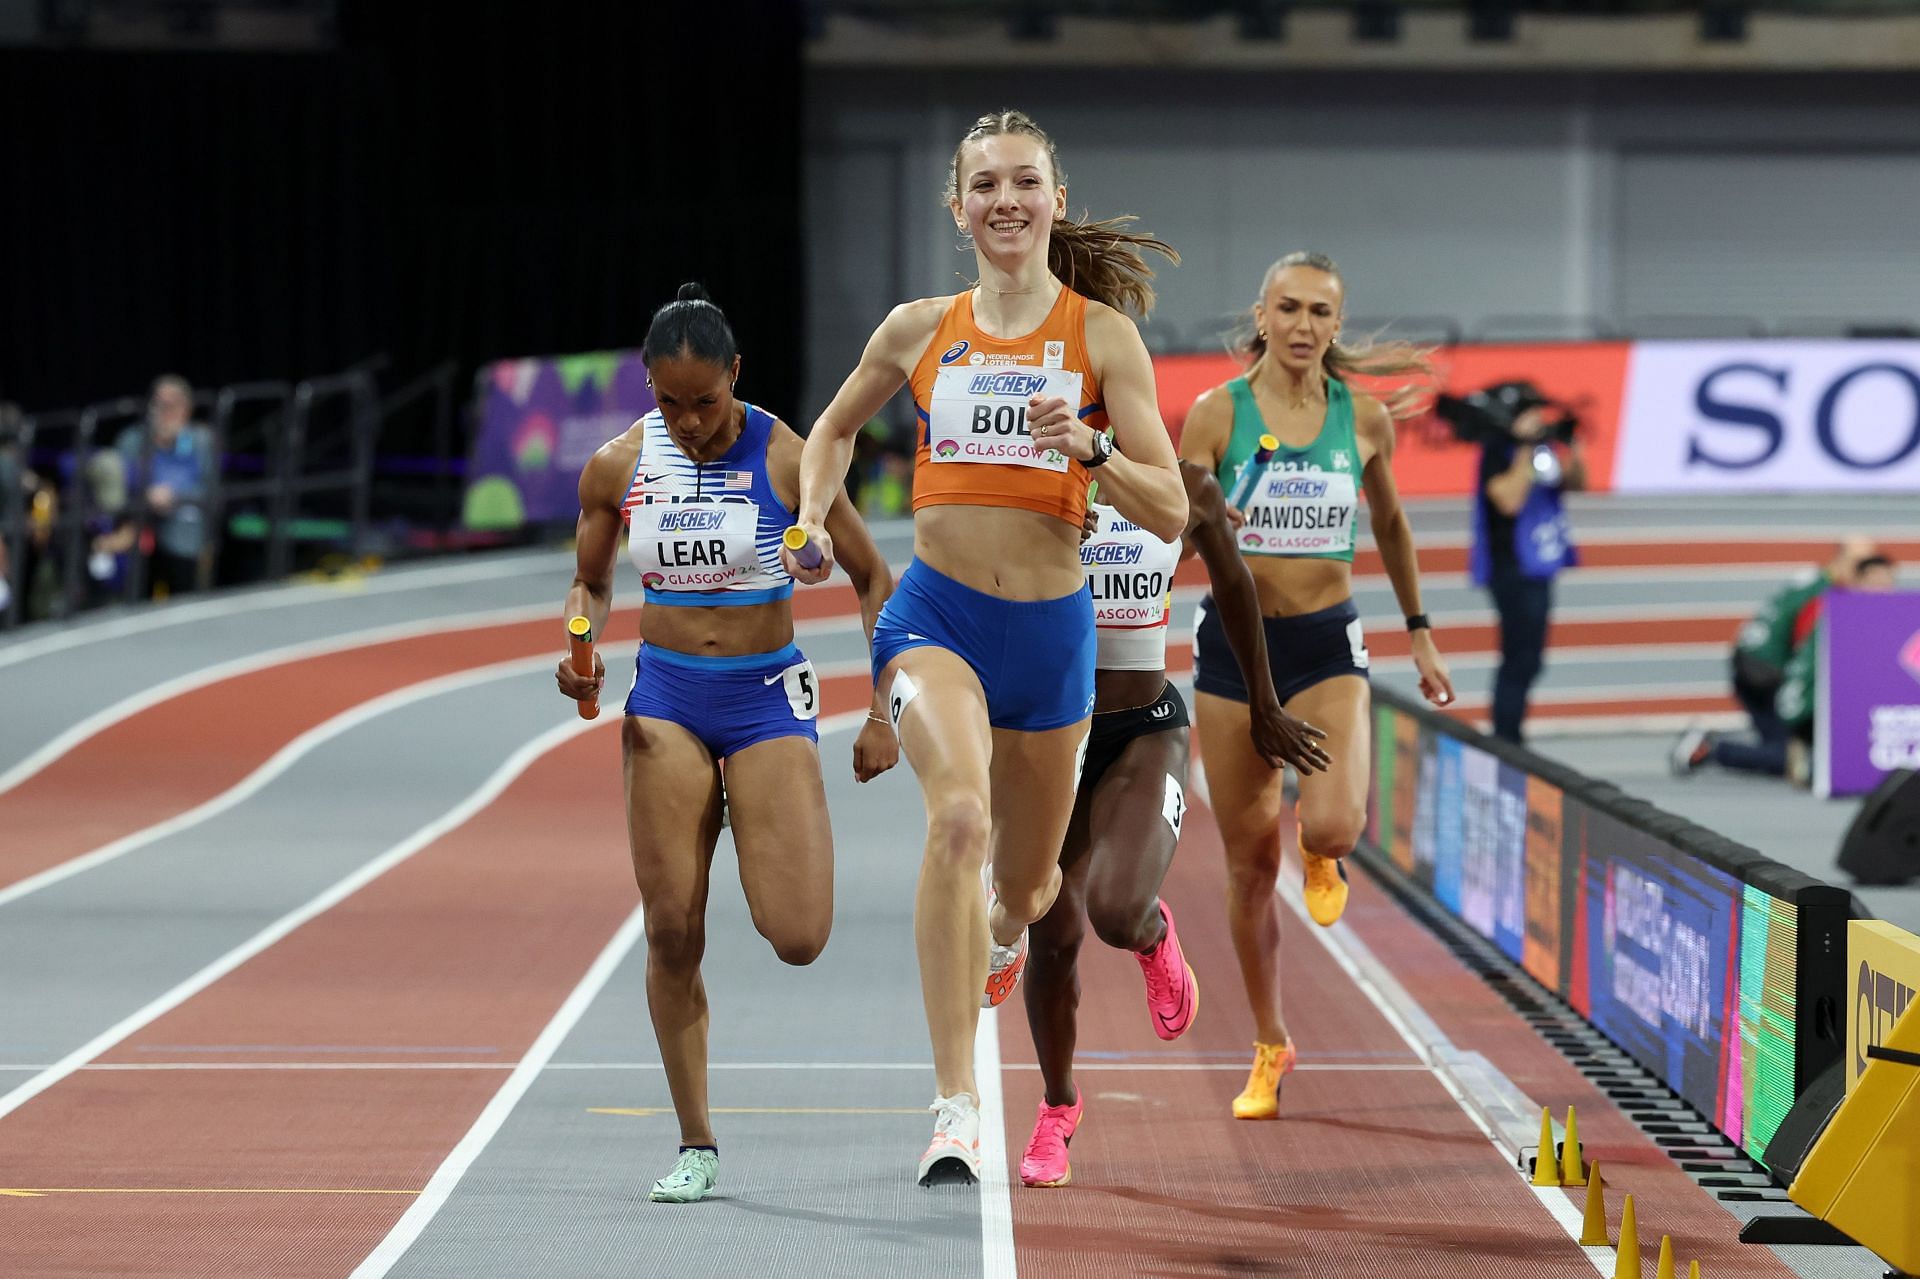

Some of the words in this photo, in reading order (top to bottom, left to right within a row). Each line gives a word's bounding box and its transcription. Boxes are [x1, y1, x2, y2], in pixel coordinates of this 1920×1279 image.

[986, 353, 1035, 361] NEDERLANDSE
[969, 374, 1046, 396] HI-CHEW
[971, 404, 1033, 436] BOL
[965, 442, 1044, 460] GLASGOW
[1047, 449, 1064, 464] 24
[1268, 480, 1328, 498] HI-CHEW
[658, 510, 726, 531] HI-CHEW
[1110, 521, 1143, 532] Allia
[1245, 506, 1349, 529] MAWDSLEY
[657, 539, 728, 567] LEAR
[1268, 536, 1330, 548] GLASGOW
[669, 568, 736, 584] GLASGOW
[1088, 572, 1162, 600] LINGO
[1096, 608, 1149, 620] ASGOW
[798, 670, 813, 711] 5
[891, 694, 902, 724] 6
[1173, 791, 1181, 828] 3
